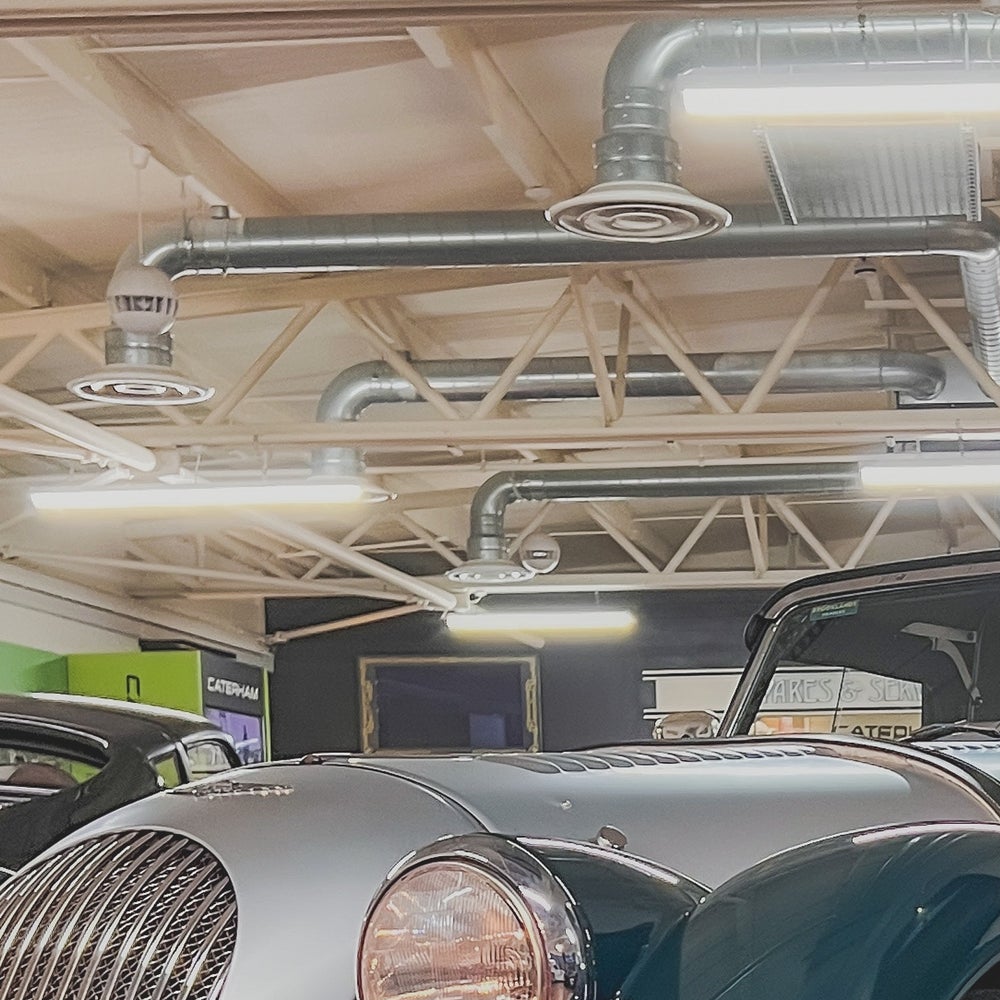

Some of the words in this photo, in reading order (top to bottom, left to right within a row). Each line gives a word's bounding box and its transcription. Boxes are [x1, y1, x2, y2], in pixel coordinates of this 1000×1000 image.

[207, 676, 259, 700] CATERHAM
[765, 678, 833, 704] ARES
[841, 680, 864, 703] &
